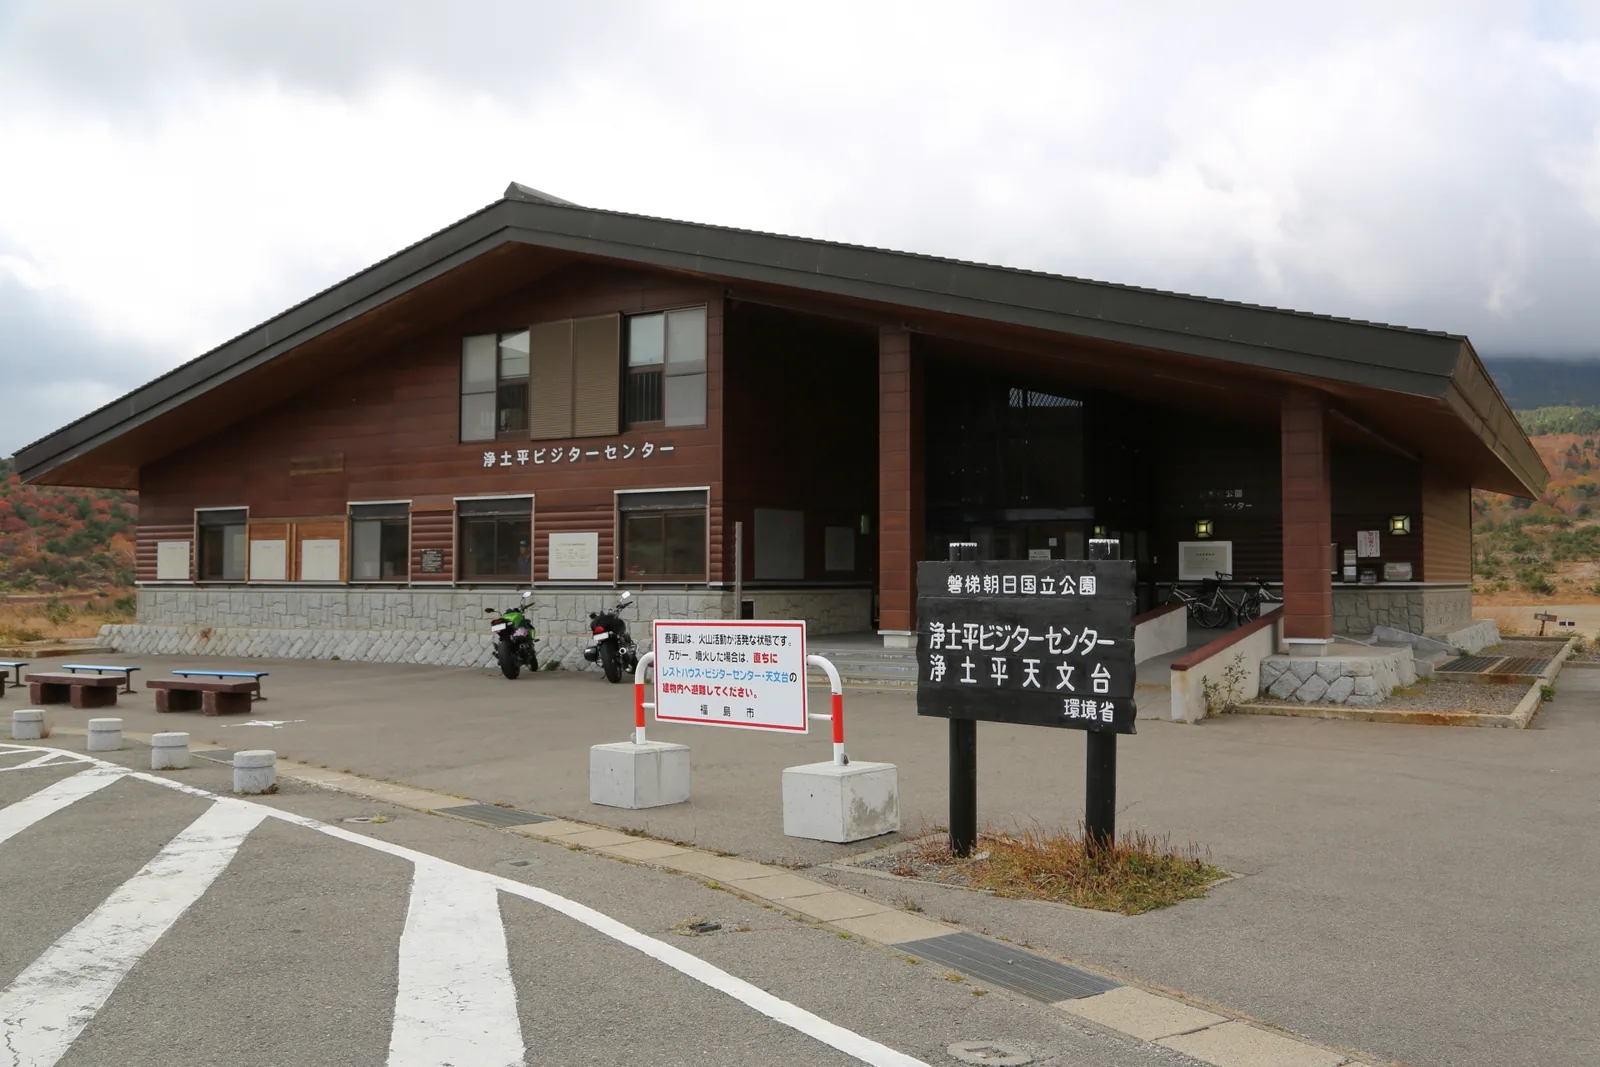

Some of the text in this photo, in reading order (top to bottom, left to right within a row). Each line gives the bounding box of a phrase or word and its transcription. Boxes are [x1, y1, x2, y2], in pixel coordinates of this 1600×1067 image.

[483, 442, 674, 468] 浄土平ビジターセンター
[947, 575, 1096, 595] 磐梯朝日国立公園
[929, 621, 1115, 656] 浄土平ビジターセンター
[929, 654, 1112, 694] 浄土平天文台
[662, 682, 758, 699] 建物内へ避難してください。
[700, 704, 755, 719] 福島市
[1063, 698, 1115, 722] 環境省
